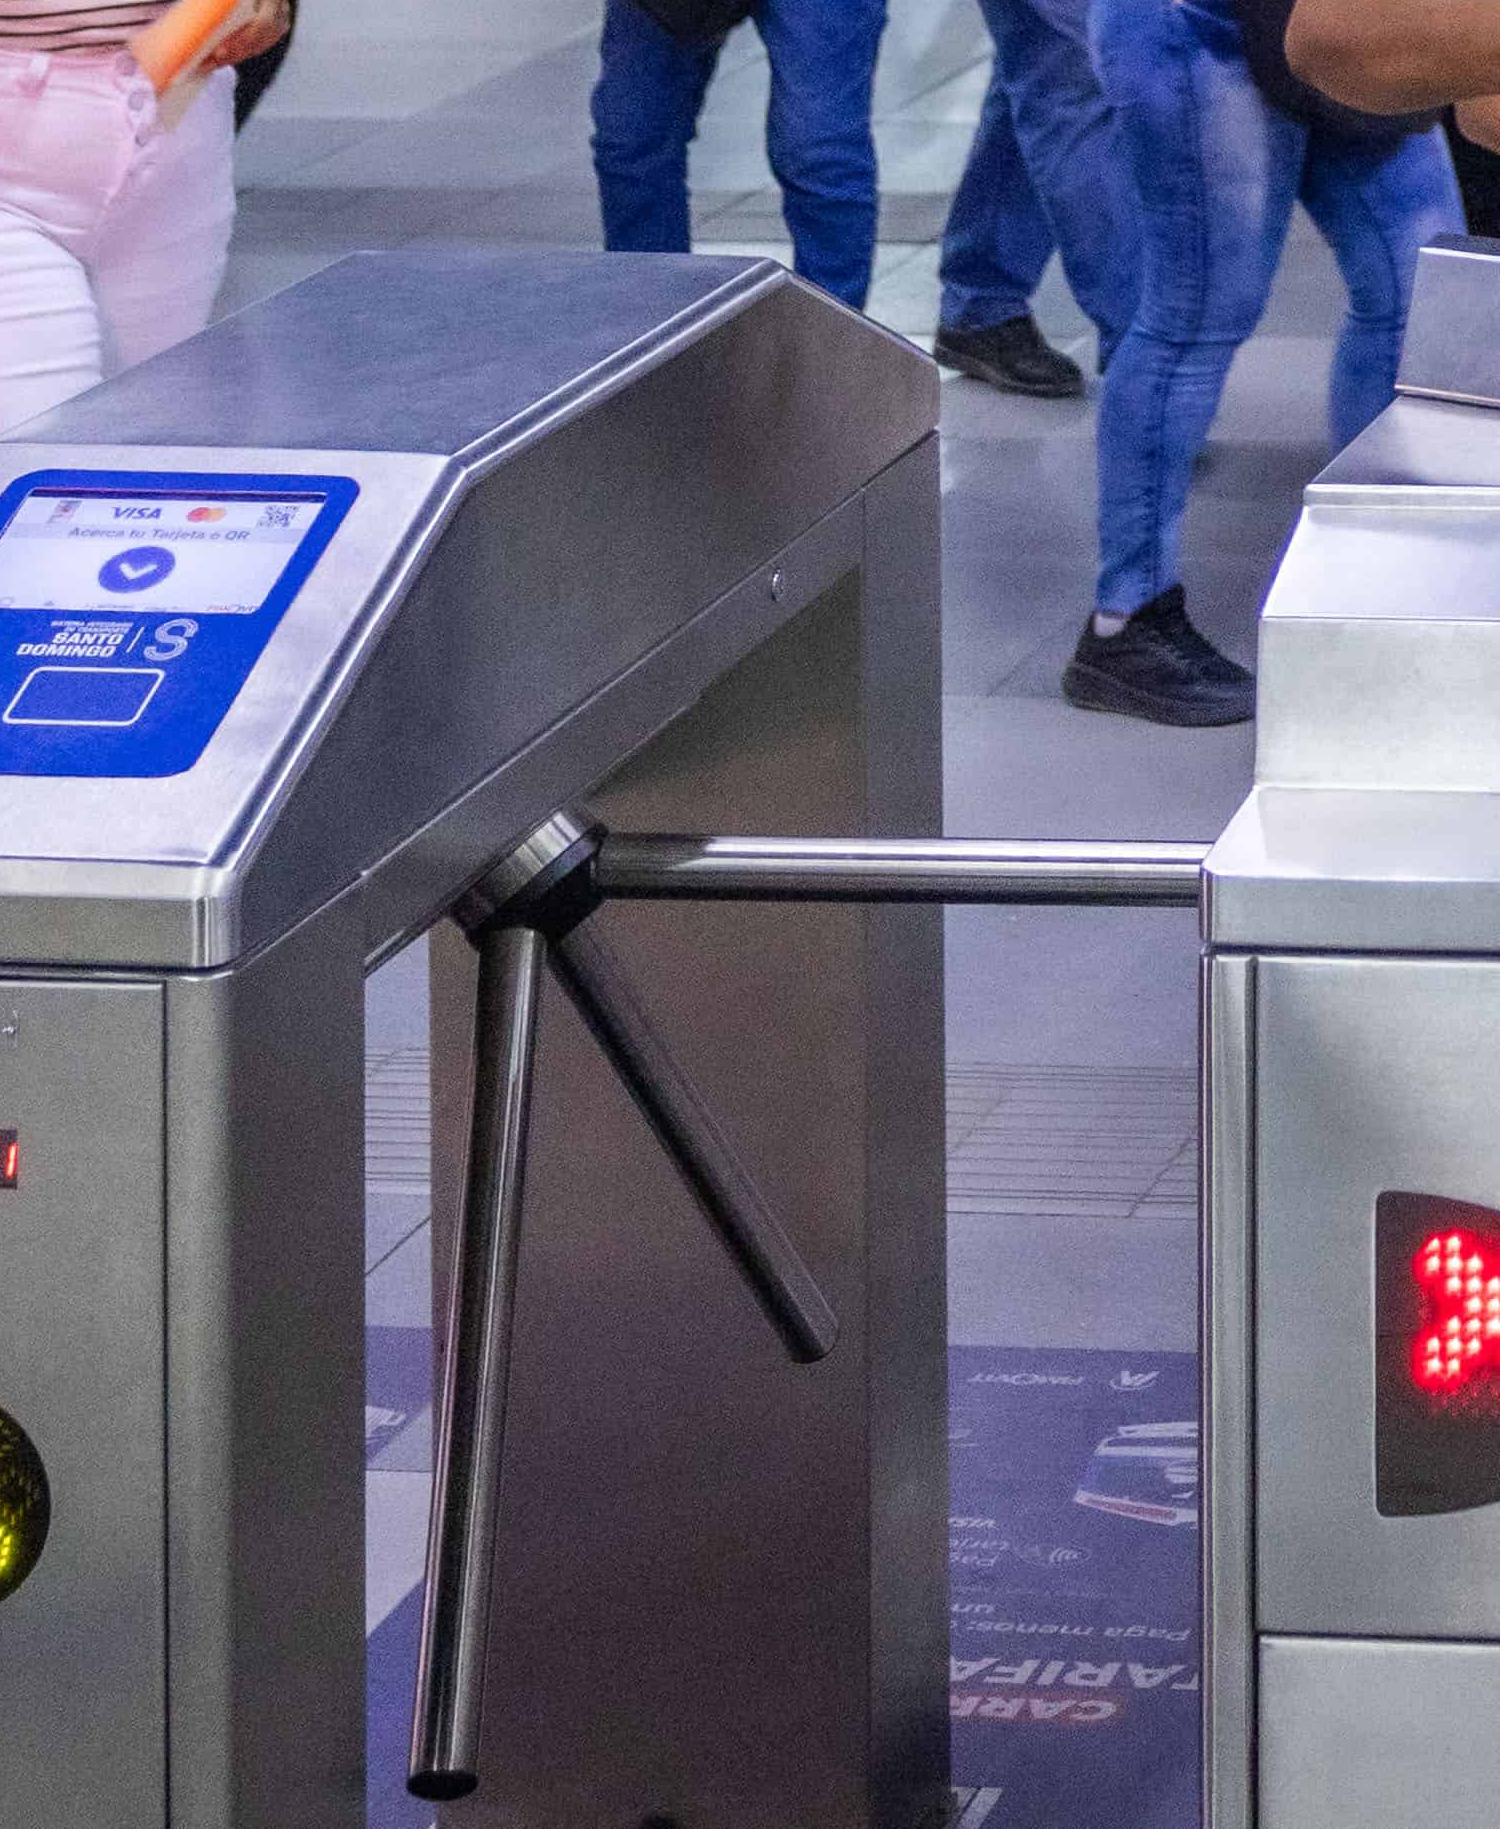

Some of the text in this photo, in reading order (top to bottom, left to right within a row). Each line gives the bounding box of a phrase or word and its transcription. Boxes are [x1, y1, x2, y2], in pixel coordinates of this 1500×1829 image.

[112, 506, 162, 519] VISA
[51, 632, 124, 645] SANTO
[16, 643, 118, 658] DOMINGO
[1104, 1626, 1193, 1642] Paga
